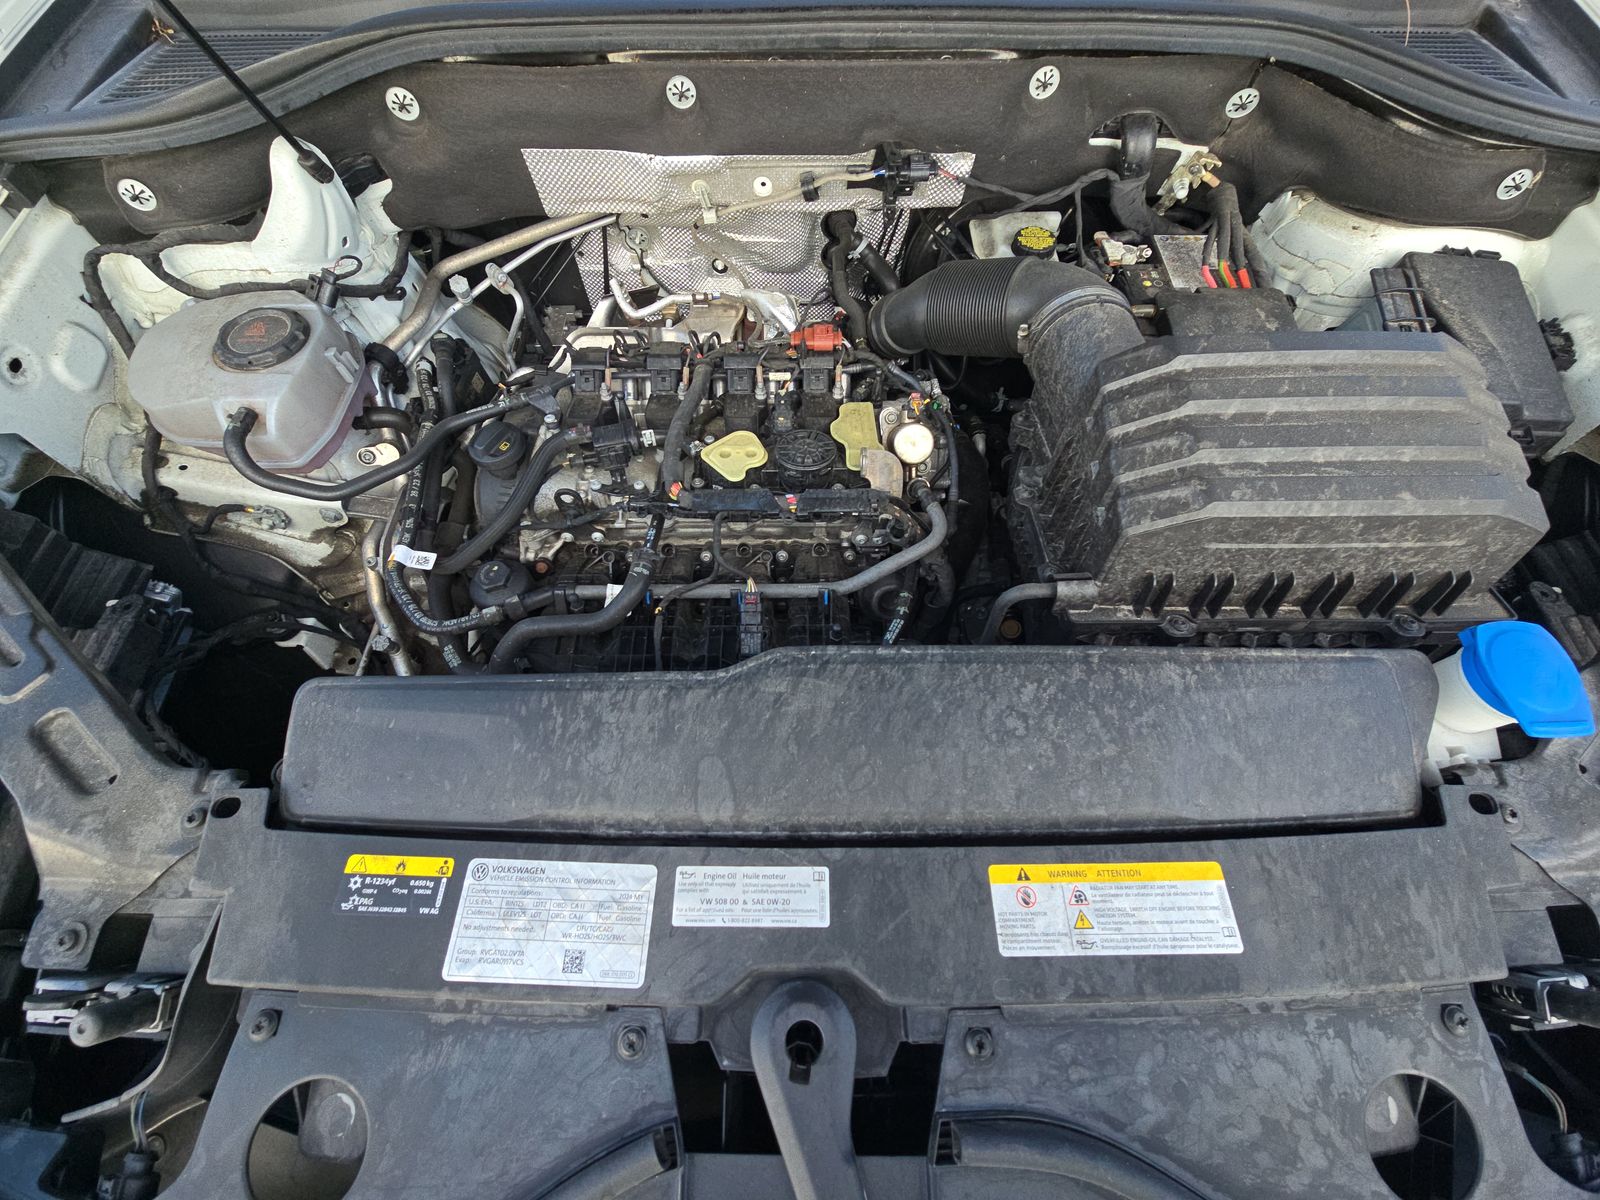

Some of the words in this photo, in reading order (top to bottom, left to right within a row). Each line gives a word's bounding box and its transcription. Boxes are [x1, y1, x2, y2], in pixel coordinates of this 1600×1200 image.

[492, 865, 546, 875] VOLKSWAGEN
[1047, 870, 1088, 878] WARNING
[1096, 869, 1142, 877] ATTENTION
[703, 872, 726, 881] Engine
[365, 877, 397, 886] R-1234yf
[426, 880, 434, 888] kg
[574, 878, 616, 886] INFORMATION
[508, 889, 543, 897] regulations:
[751, 898, 765, 906] SAE
[766, 898, 791, 906] 0W-20
[615, 914, 642, 922] Gasoline
[472, 924, 510, 933] adjustments
